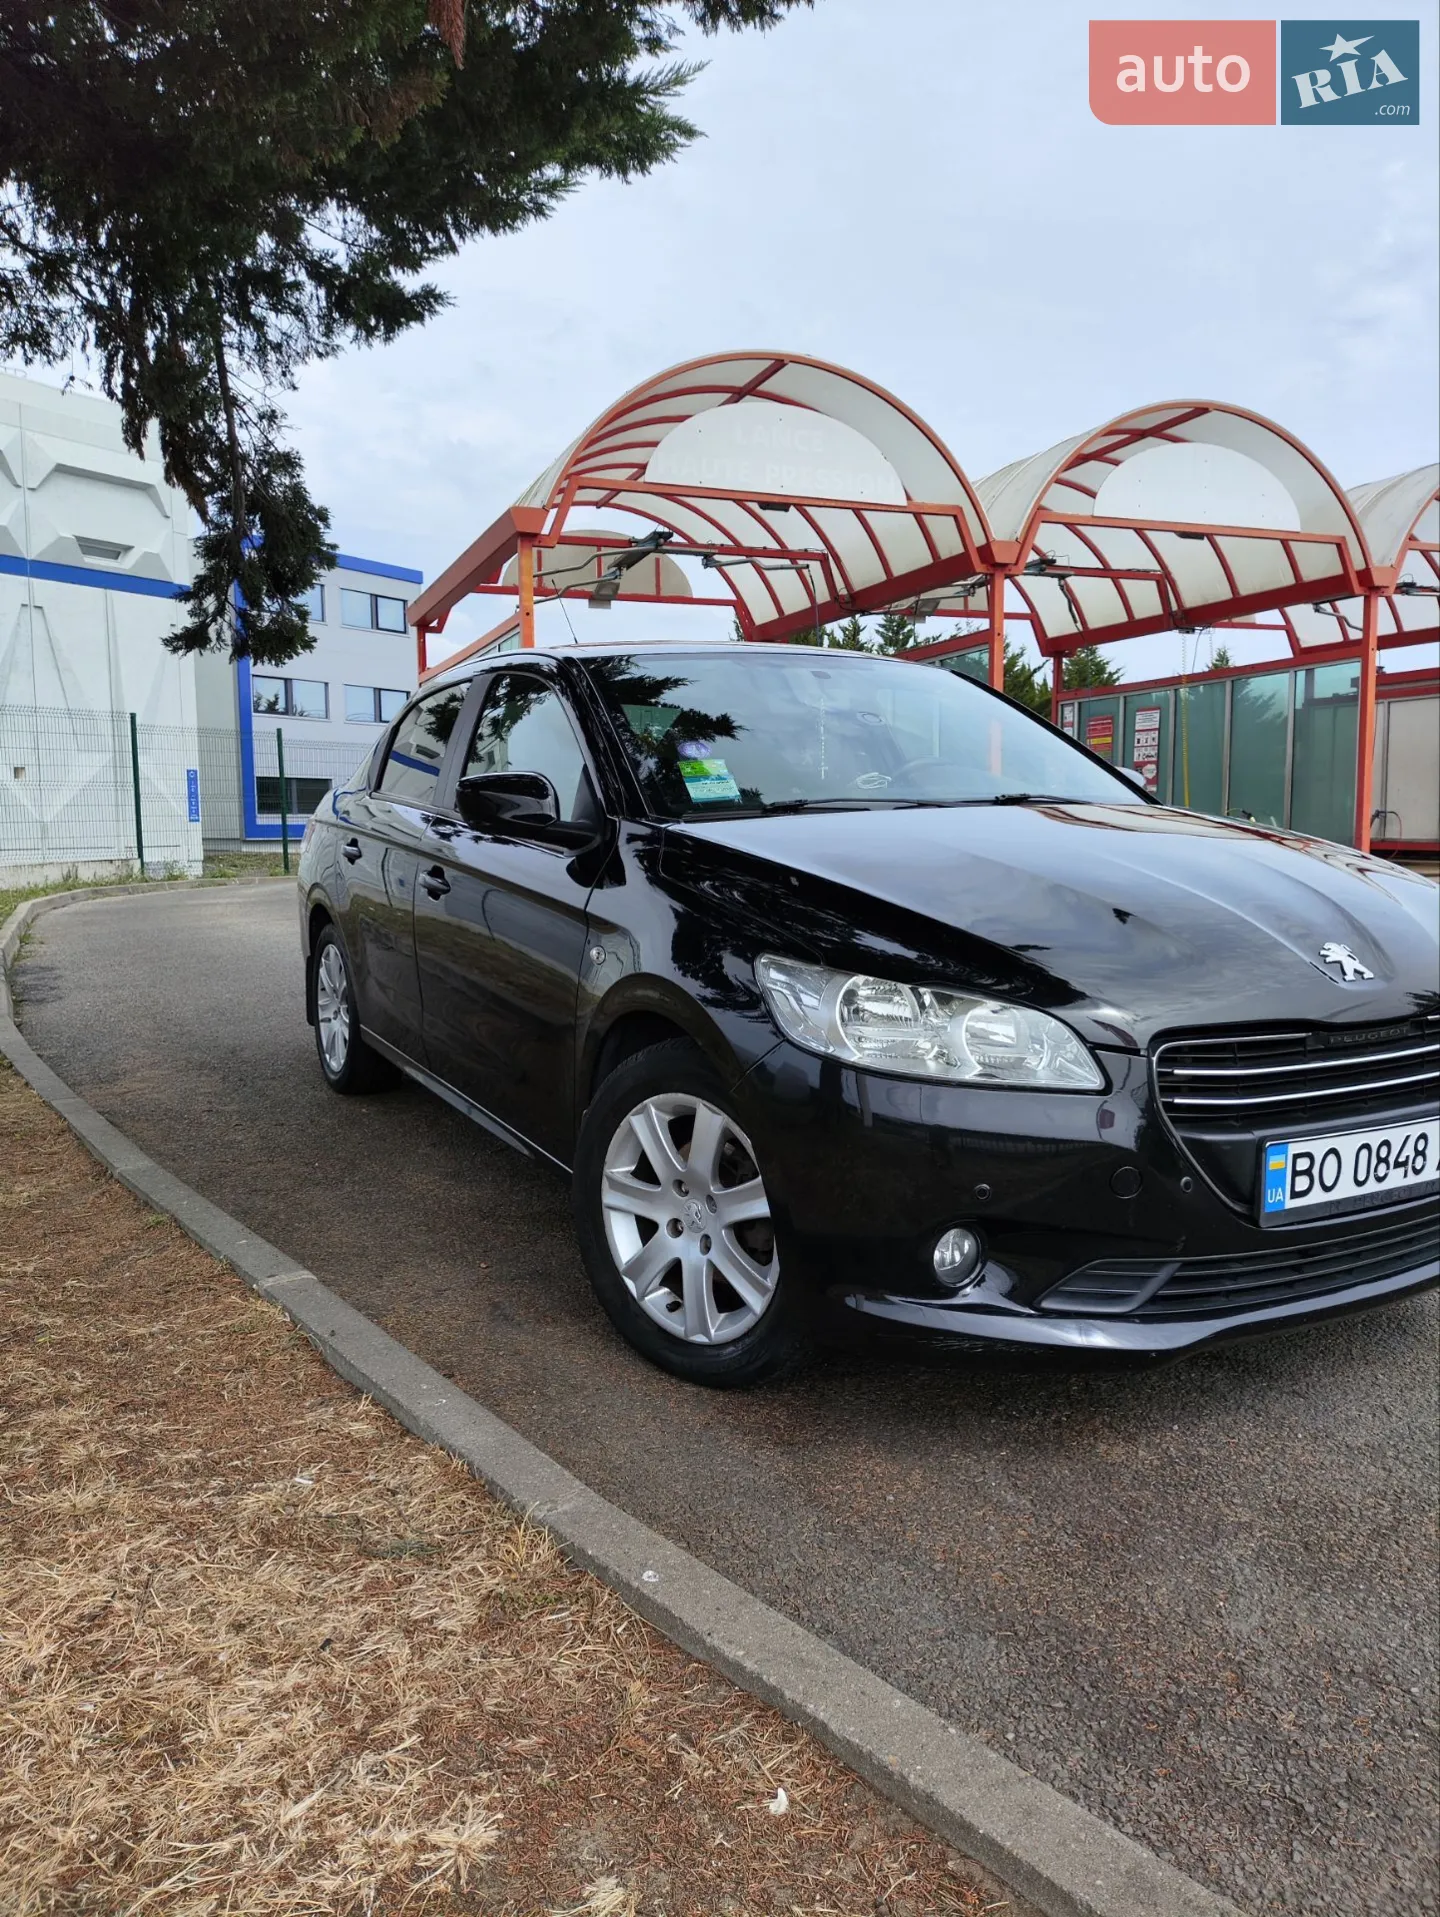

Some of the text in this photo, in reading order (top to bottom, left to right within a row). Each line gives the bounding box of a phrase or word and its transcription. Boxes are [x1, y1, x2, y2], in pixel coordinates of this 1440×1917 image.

[735, 421, 825, 453] LANCE
[765, 460, 896, 498] PRESSION
[1330, 1027, 1408, 1044] PEUGEOT
[1289, 1147, 1342, 1200] BO
[1353, 1132, 1429, 1188] 0848
[1267, 1187, 1284, 1203] UA
